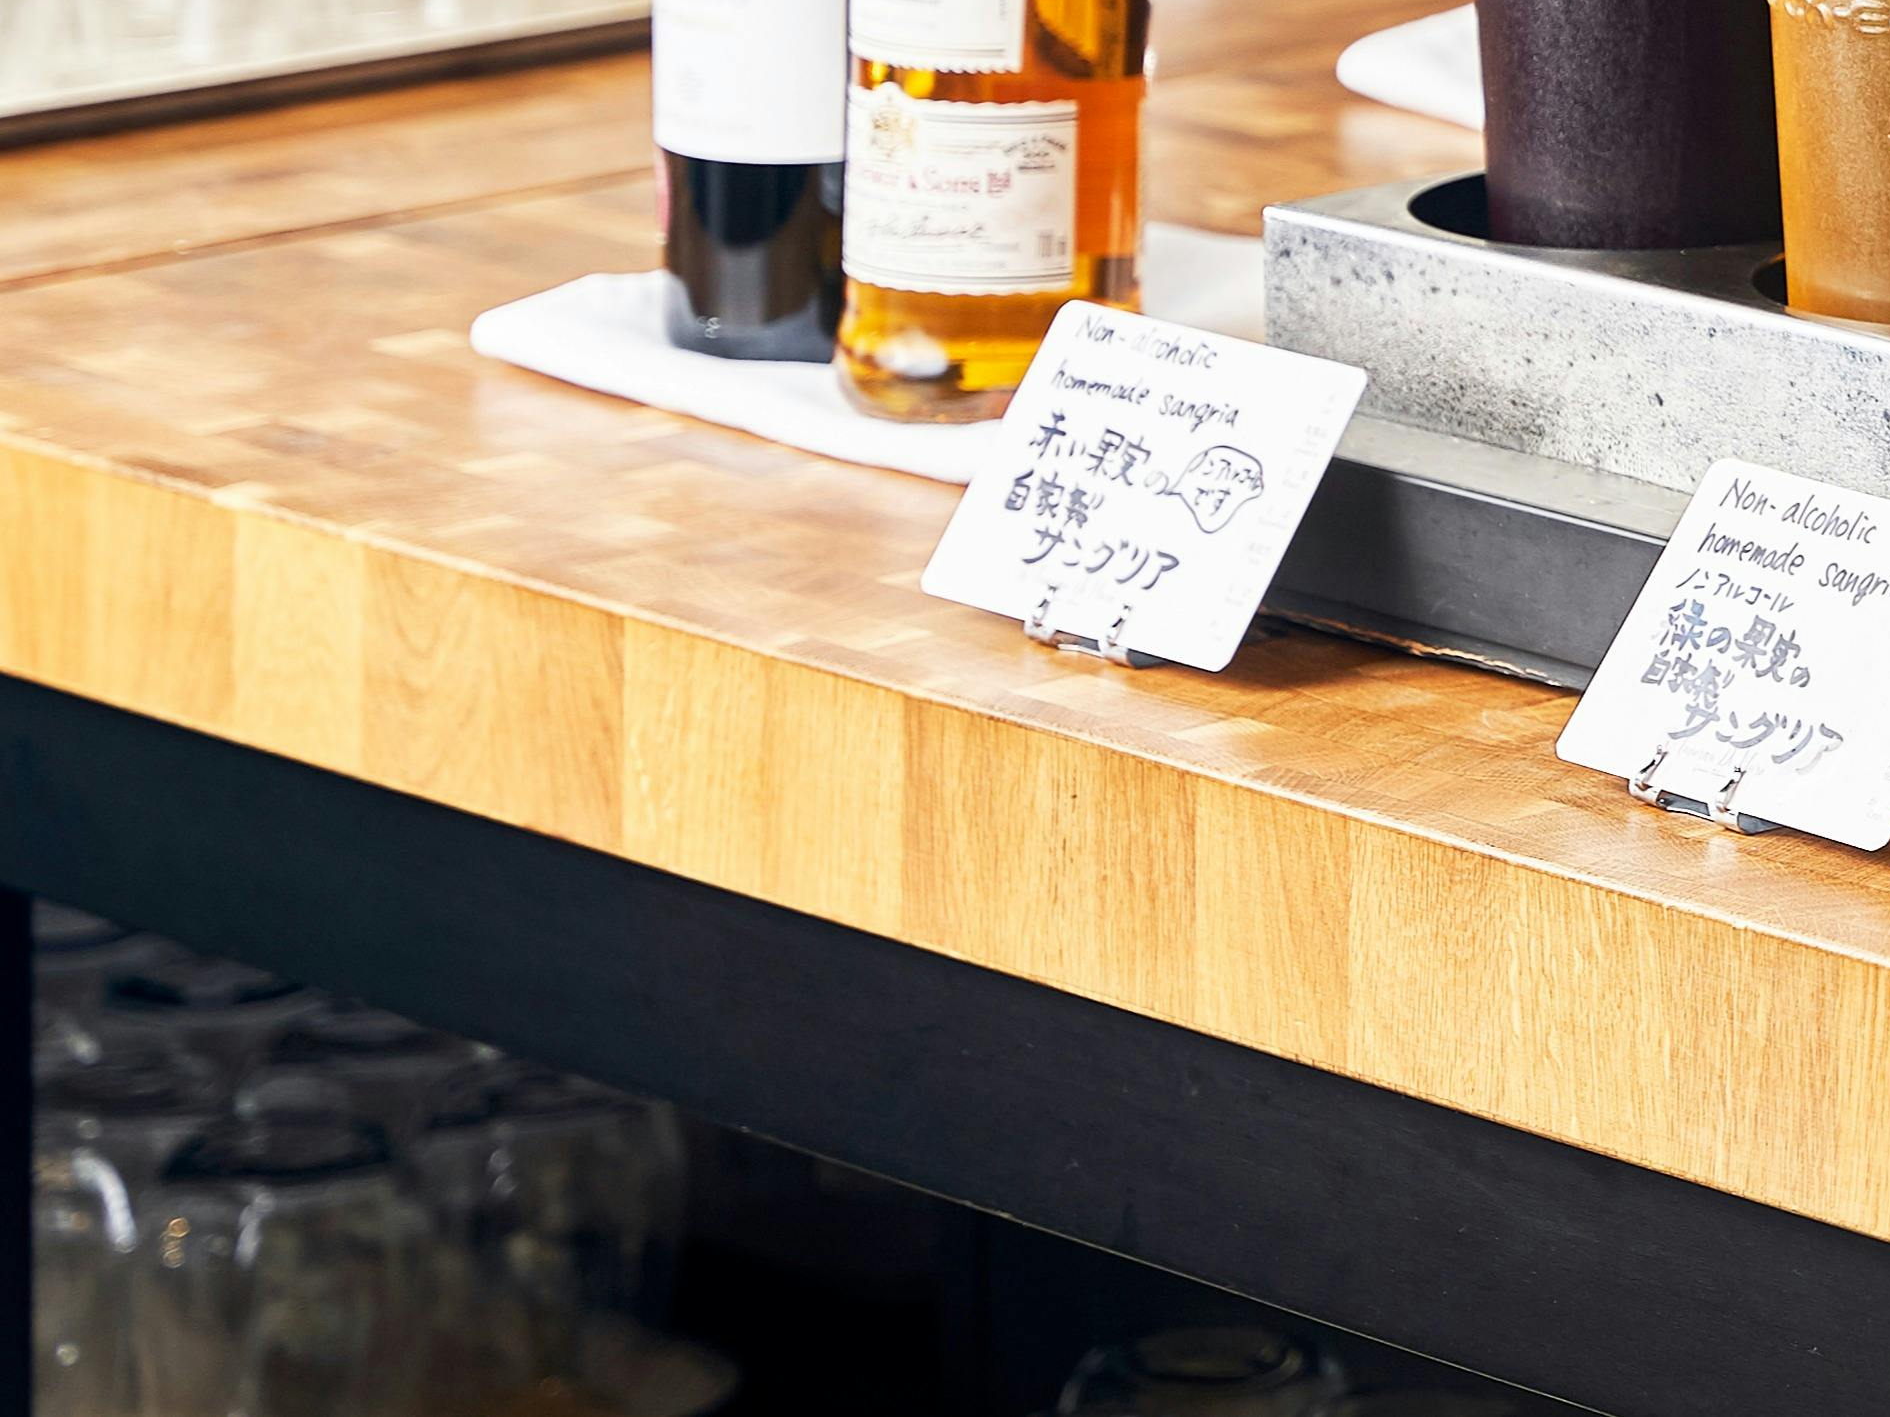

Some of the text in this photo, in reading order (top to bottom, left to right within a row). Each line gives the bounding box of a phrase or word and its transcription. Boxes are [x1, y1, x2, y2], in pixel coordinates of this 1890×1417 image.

[1050, 356, 1239, 433] homemade sangria
[1028, 409, 1170, 495] 赤い果実の
[1718, 476, 1877, 545] Non-alcoholic
[1021, 526, 1180, 591] サングリア
[1697, 521, 1806, 578] homemade
[1675, 567, 1795, 613] ノンアルコール
[1667, 702, 1844, 773] サングリア
